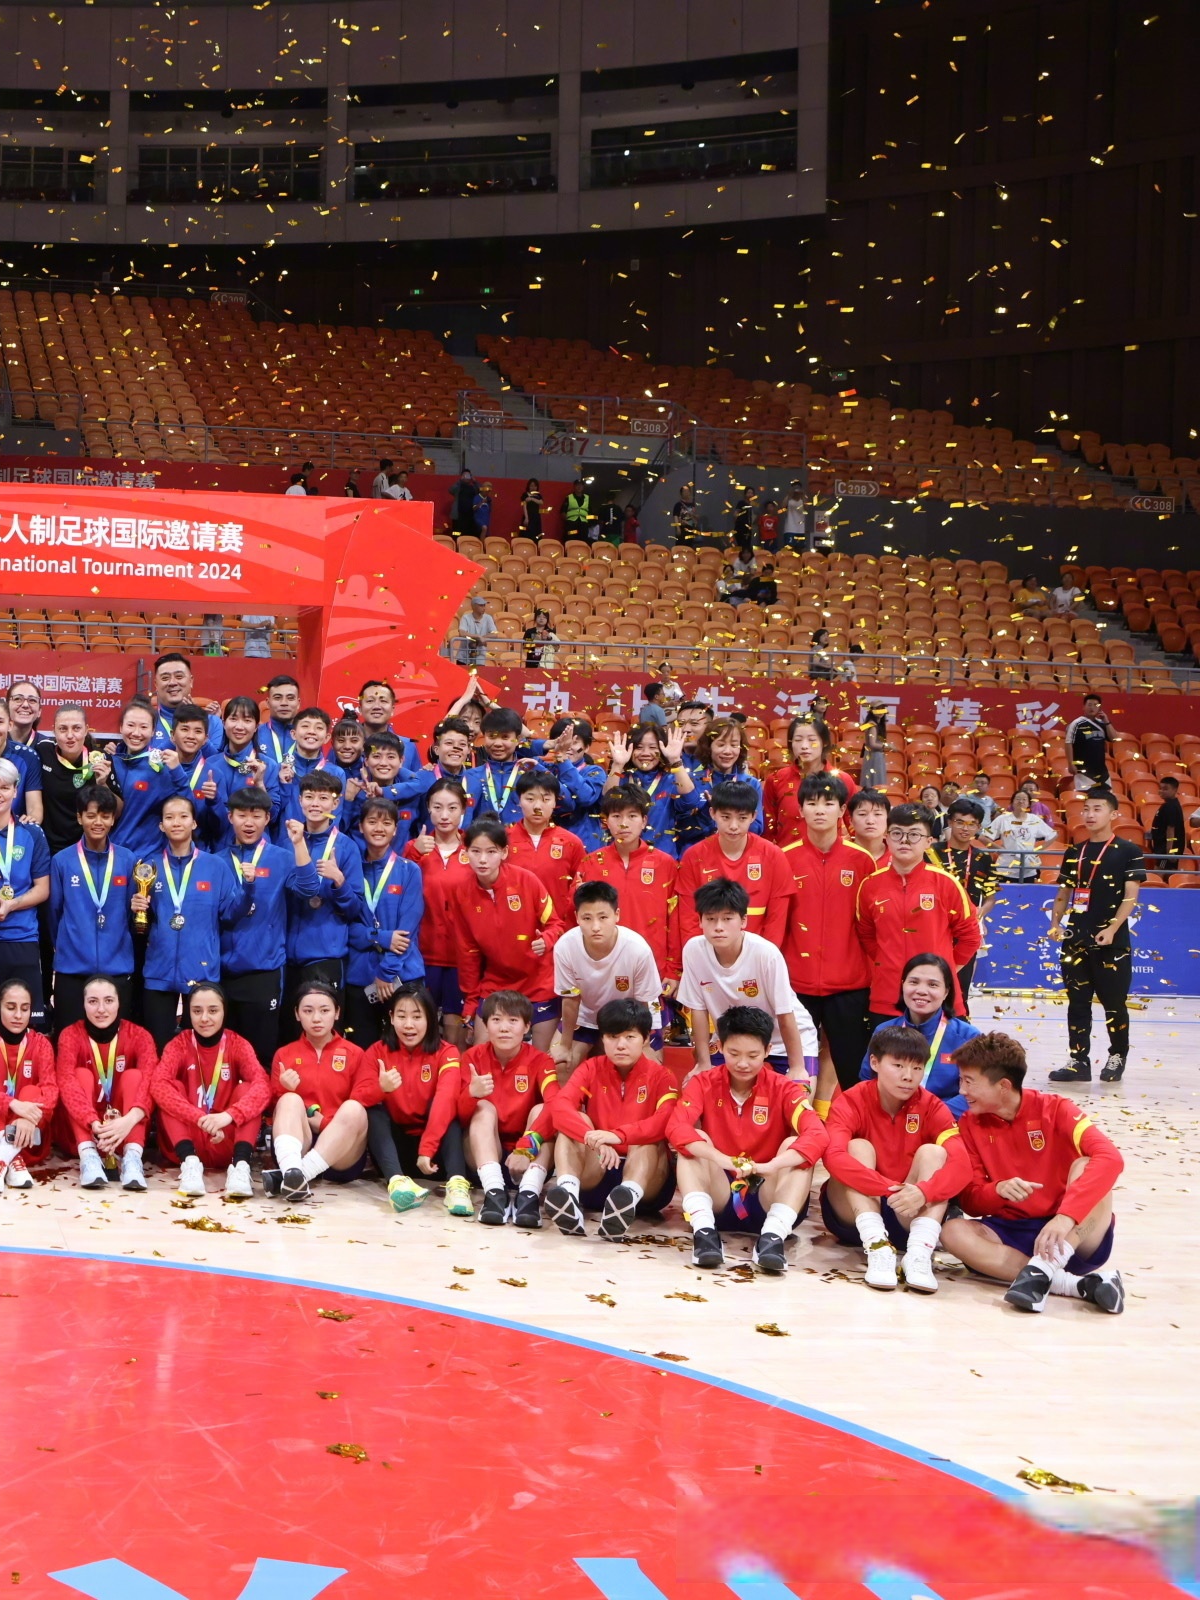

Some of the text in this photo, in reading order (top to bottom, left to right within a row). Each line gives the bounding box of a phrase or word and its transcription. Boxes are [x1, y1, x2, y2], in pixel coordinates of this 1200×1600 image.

[633, 420, 661, 433] C308
[547, 437, 589, 456] 207
[1143, 498, 1172, 511] C308
[81, 557, 194, 578] Tournament
[197, 562, 242, 581] 2024
[41, 698, 93, 708] urnament
[95, 699, 122, 709] 2024
[1131, 966, 1154, 974] NTER
[717, 1099, 723, 1107] 6
